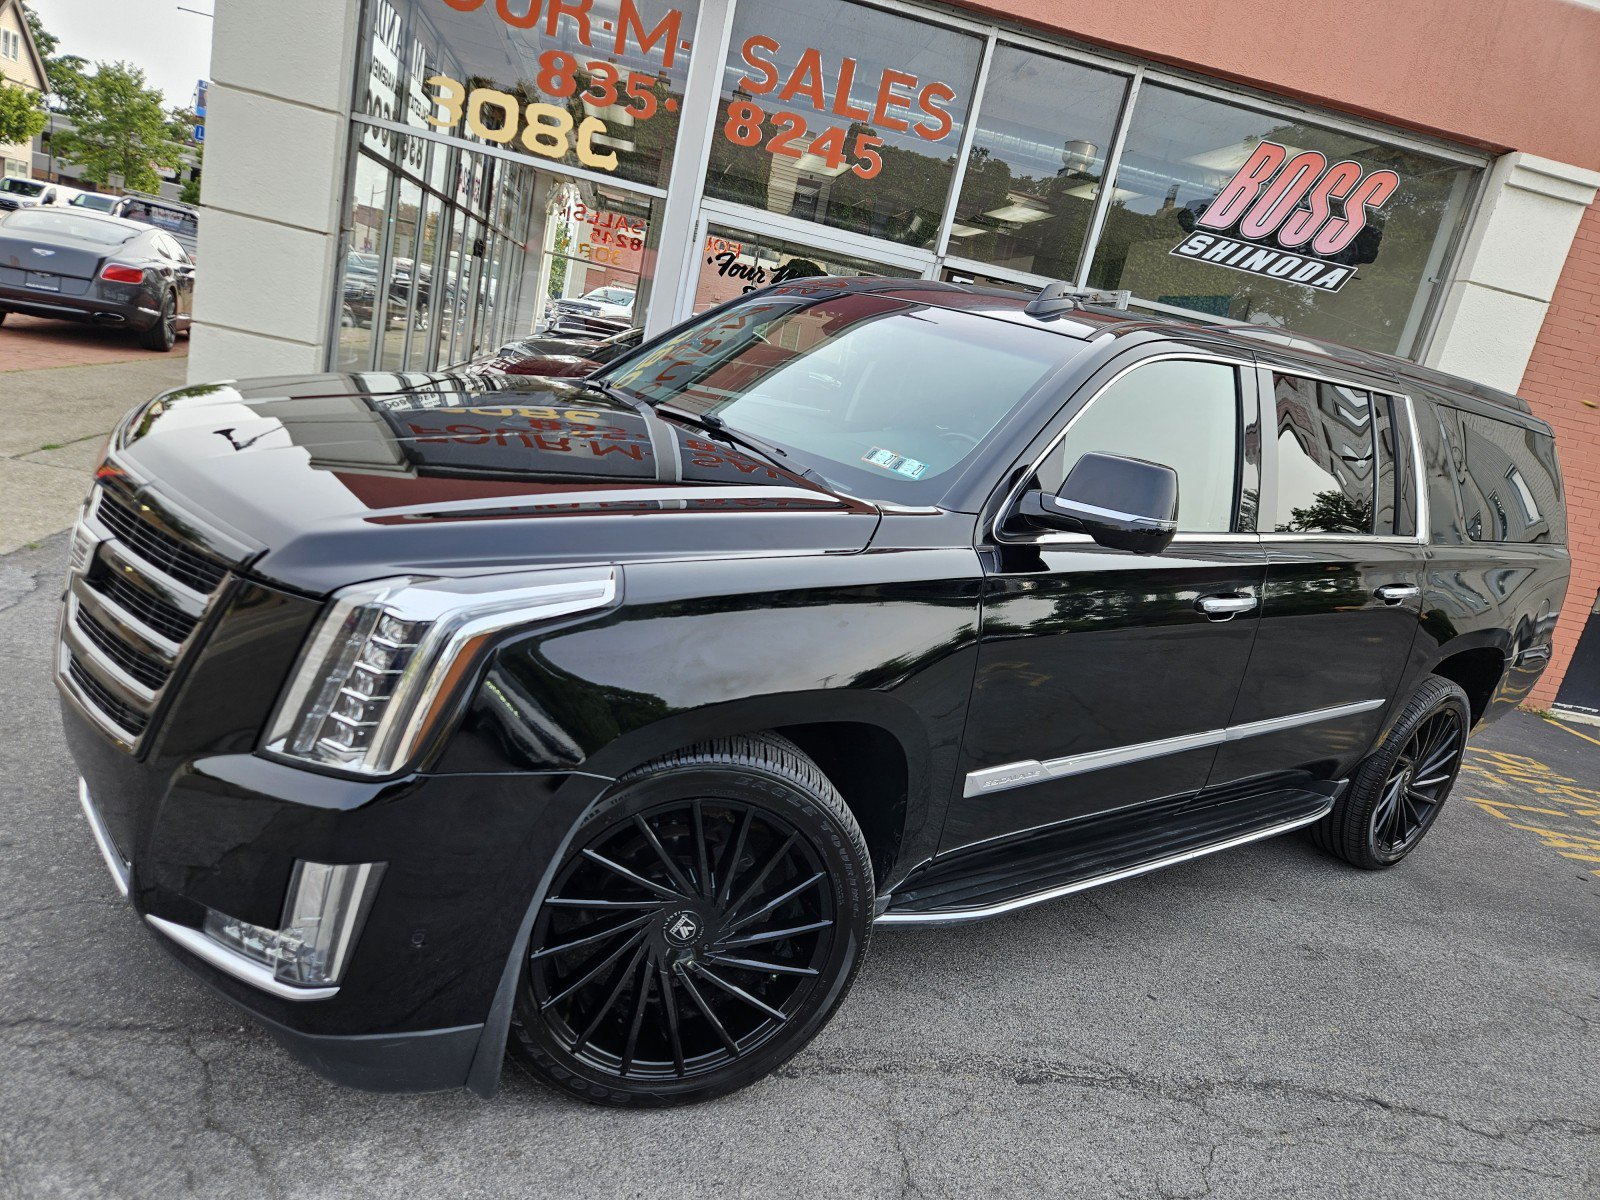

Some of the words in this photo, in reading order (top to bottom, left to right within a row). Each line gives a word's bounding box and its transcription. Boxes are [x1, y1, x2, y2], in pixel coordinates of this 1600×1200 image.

[737, 34, 957, 142] SALES
[724, 100, 885, 180] 8245
[1196, 140, 1400, 256] BOSS
[1179, 234, 1349, 290] SHINODA
